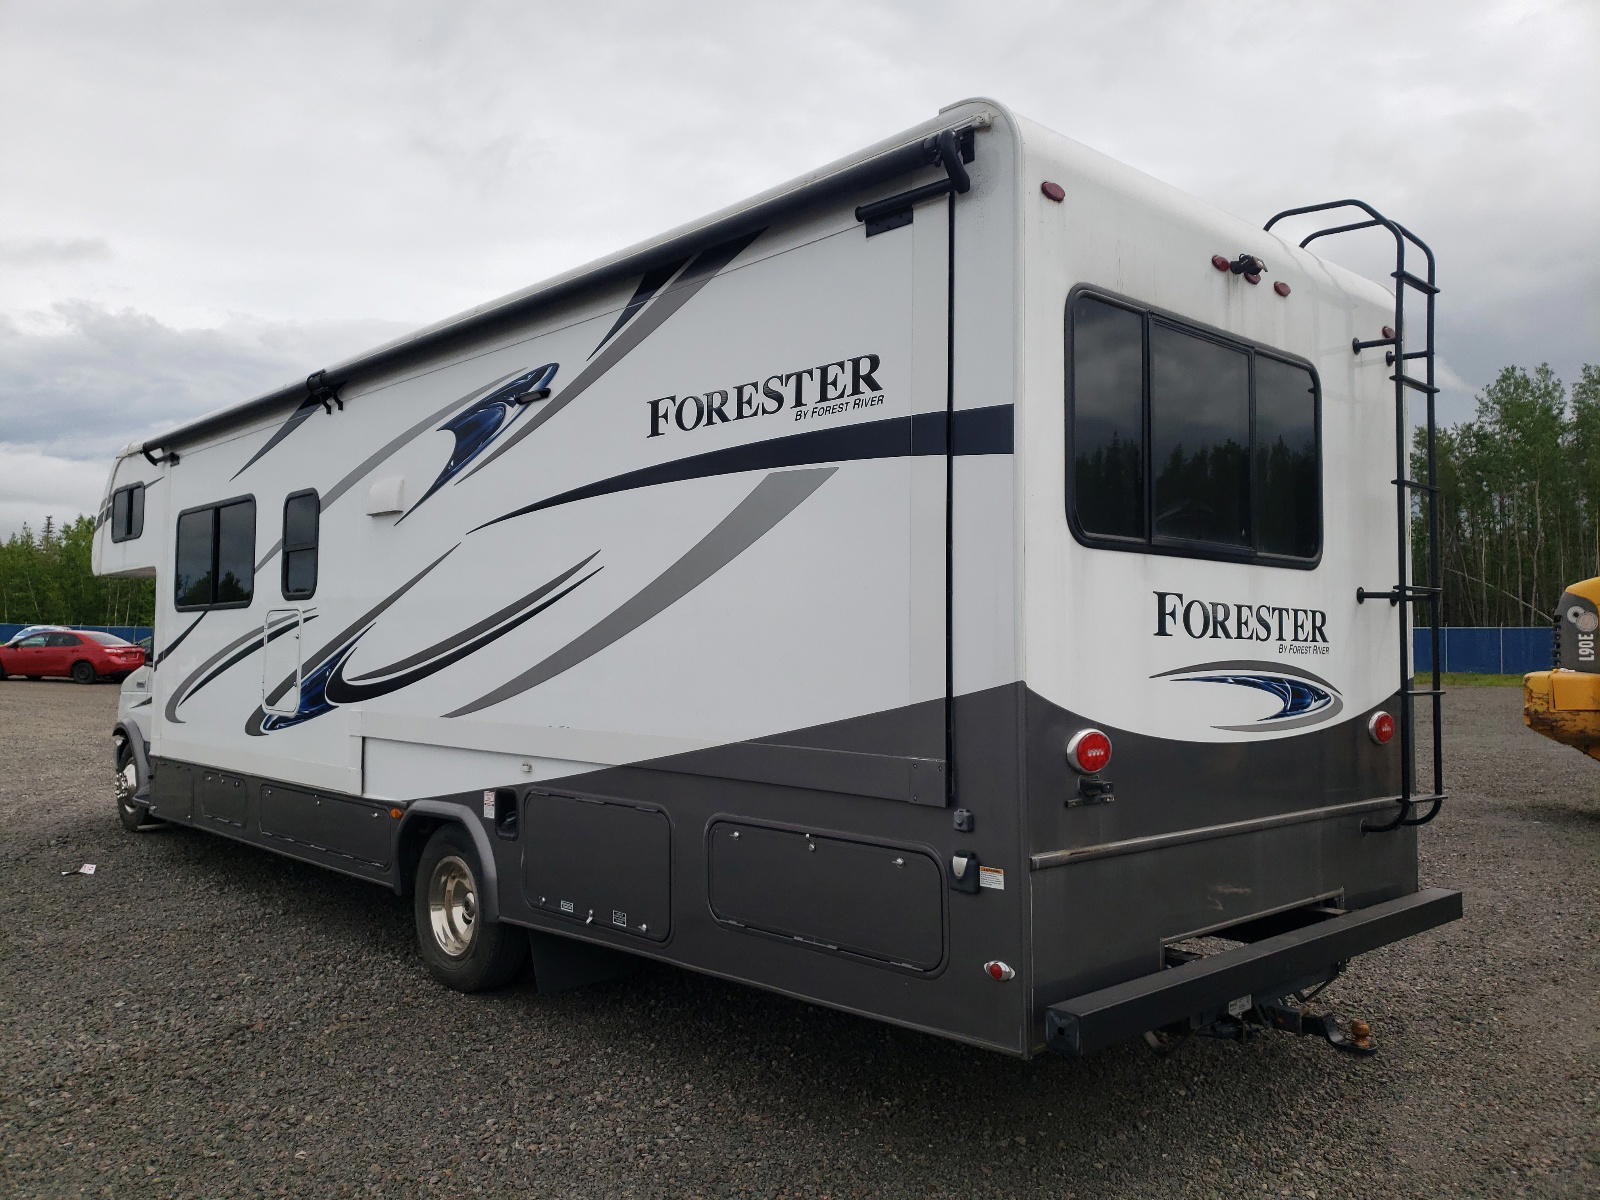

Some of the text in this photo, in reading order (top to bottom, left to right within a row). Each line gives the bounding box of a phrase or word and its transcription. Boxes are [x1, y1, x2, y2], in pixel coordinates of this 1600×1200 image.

[647, 353, 883, 438] FORESTER
[794, 394, 884, 421] BY FOREST RIVER
[1153, 590, 1329, 643] FORESTER
[1278, 643, 1330, 655] BY FOREST RIVER
[1578, 633, 1595, 662] L90E
